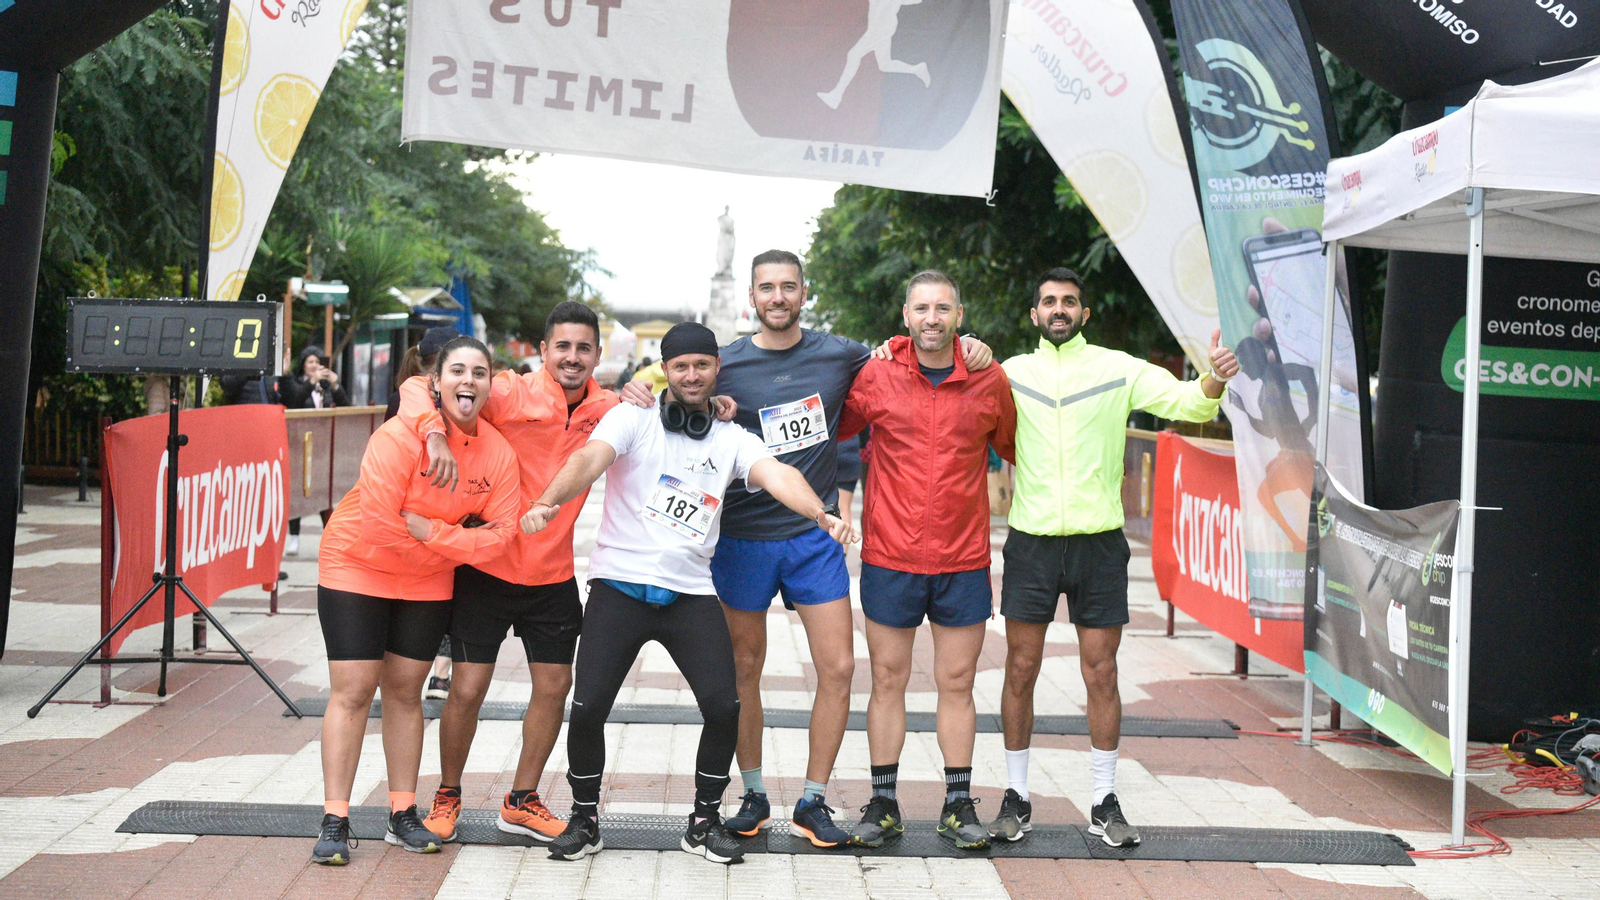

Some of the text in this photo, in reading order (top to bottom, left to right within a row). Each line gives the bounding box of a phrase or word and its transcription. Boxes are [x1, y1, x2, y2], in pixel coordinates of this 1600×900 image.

[1412, 0, 1480, 45] OMISO
[1517, 295, 1600, 314] cronome
[1487, 319, 1565, 337] eventos
[779, 416, 812, 441] 192
[154, 449, 284, 574] Cuzcampo
[665, 495, 699, 523] 187
